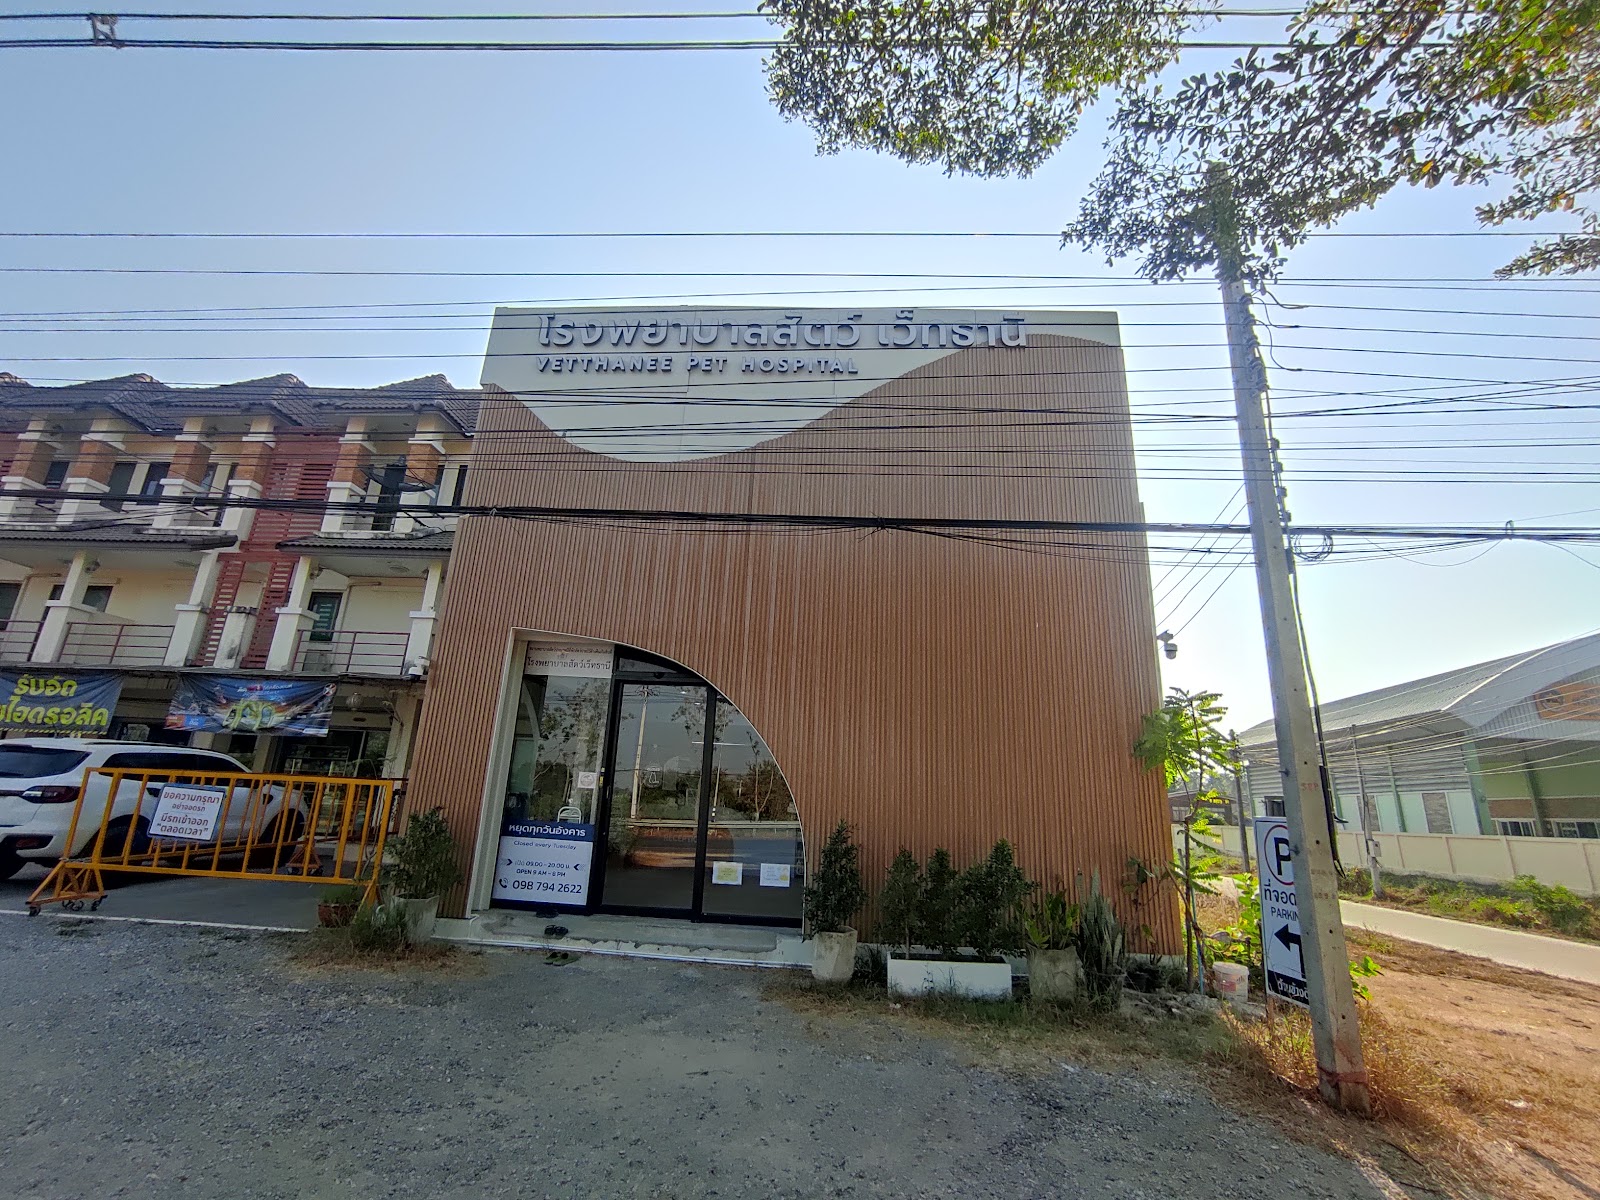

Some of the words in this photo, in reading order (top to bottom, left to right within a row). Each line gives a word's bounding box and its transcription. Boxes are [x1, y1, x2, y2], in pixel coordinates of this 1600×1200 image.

[536, 312, 863, 348] โรงพยาบาลสัตว์
[535, 356, 673, 373] VETTHANEE
[686, 356, 728, 373] PET
[741, 356, 859, 374] HOSPITAL
[14, 674, 78, 697] รับอัด
[163, 791, 220, 805] ขอความกรุณา
[160, 812, 209, 826] มีรถเข้าออก
[508, 824, 586, 837] หยุดทุกวันอังคาร
[663, 834, 697, 844] RECEPTIO
[512, 880, 534, 890] 098
[536, 881, 555, 892] 794
[557, 883, 582, 894] 2622
[1270, 906, 1299, 921] PARKIN
